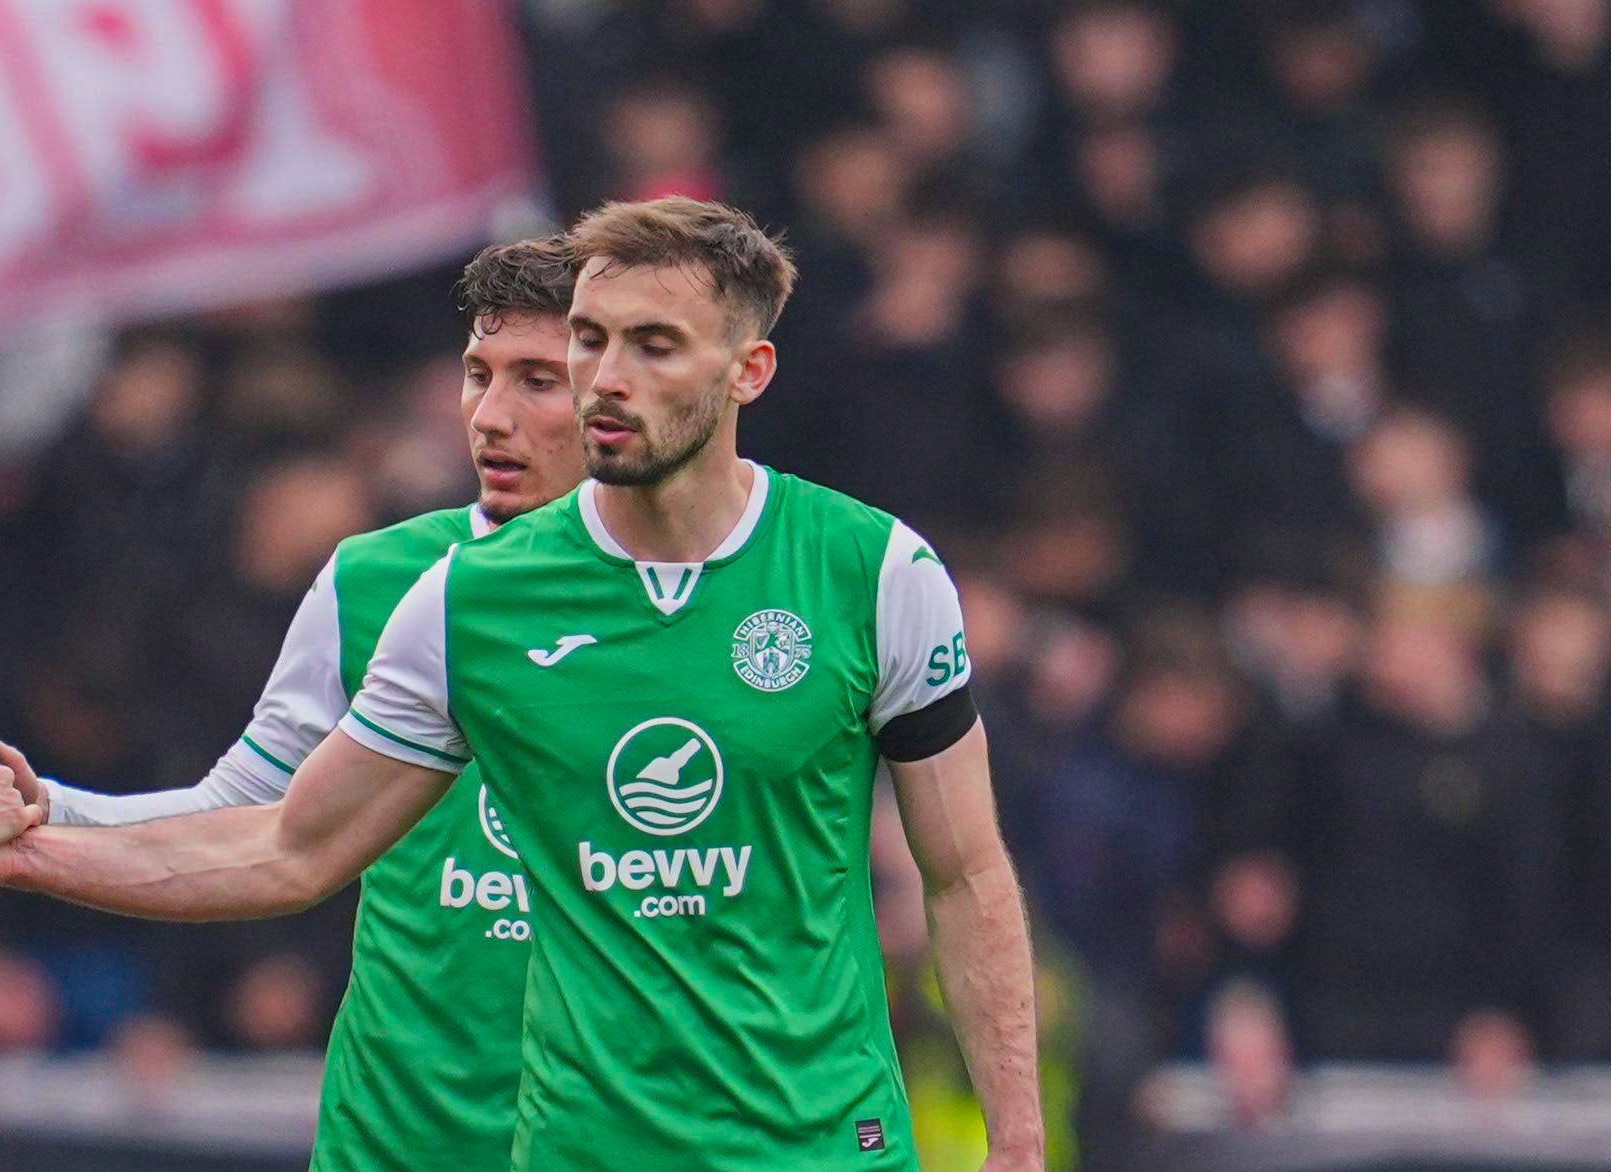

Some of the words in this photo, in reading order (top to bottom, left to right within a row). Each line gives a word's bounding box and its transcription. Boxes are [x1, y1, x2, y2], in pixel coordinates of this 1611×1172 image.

[737, 611, 807, 637] HIBERNIAN
[739, 665, 802, 690] EDINBURGH
[578, 837, 752, 897] bevvy
[634, 894, 705, 917] .com
[484, 918, 533, 942] .co
